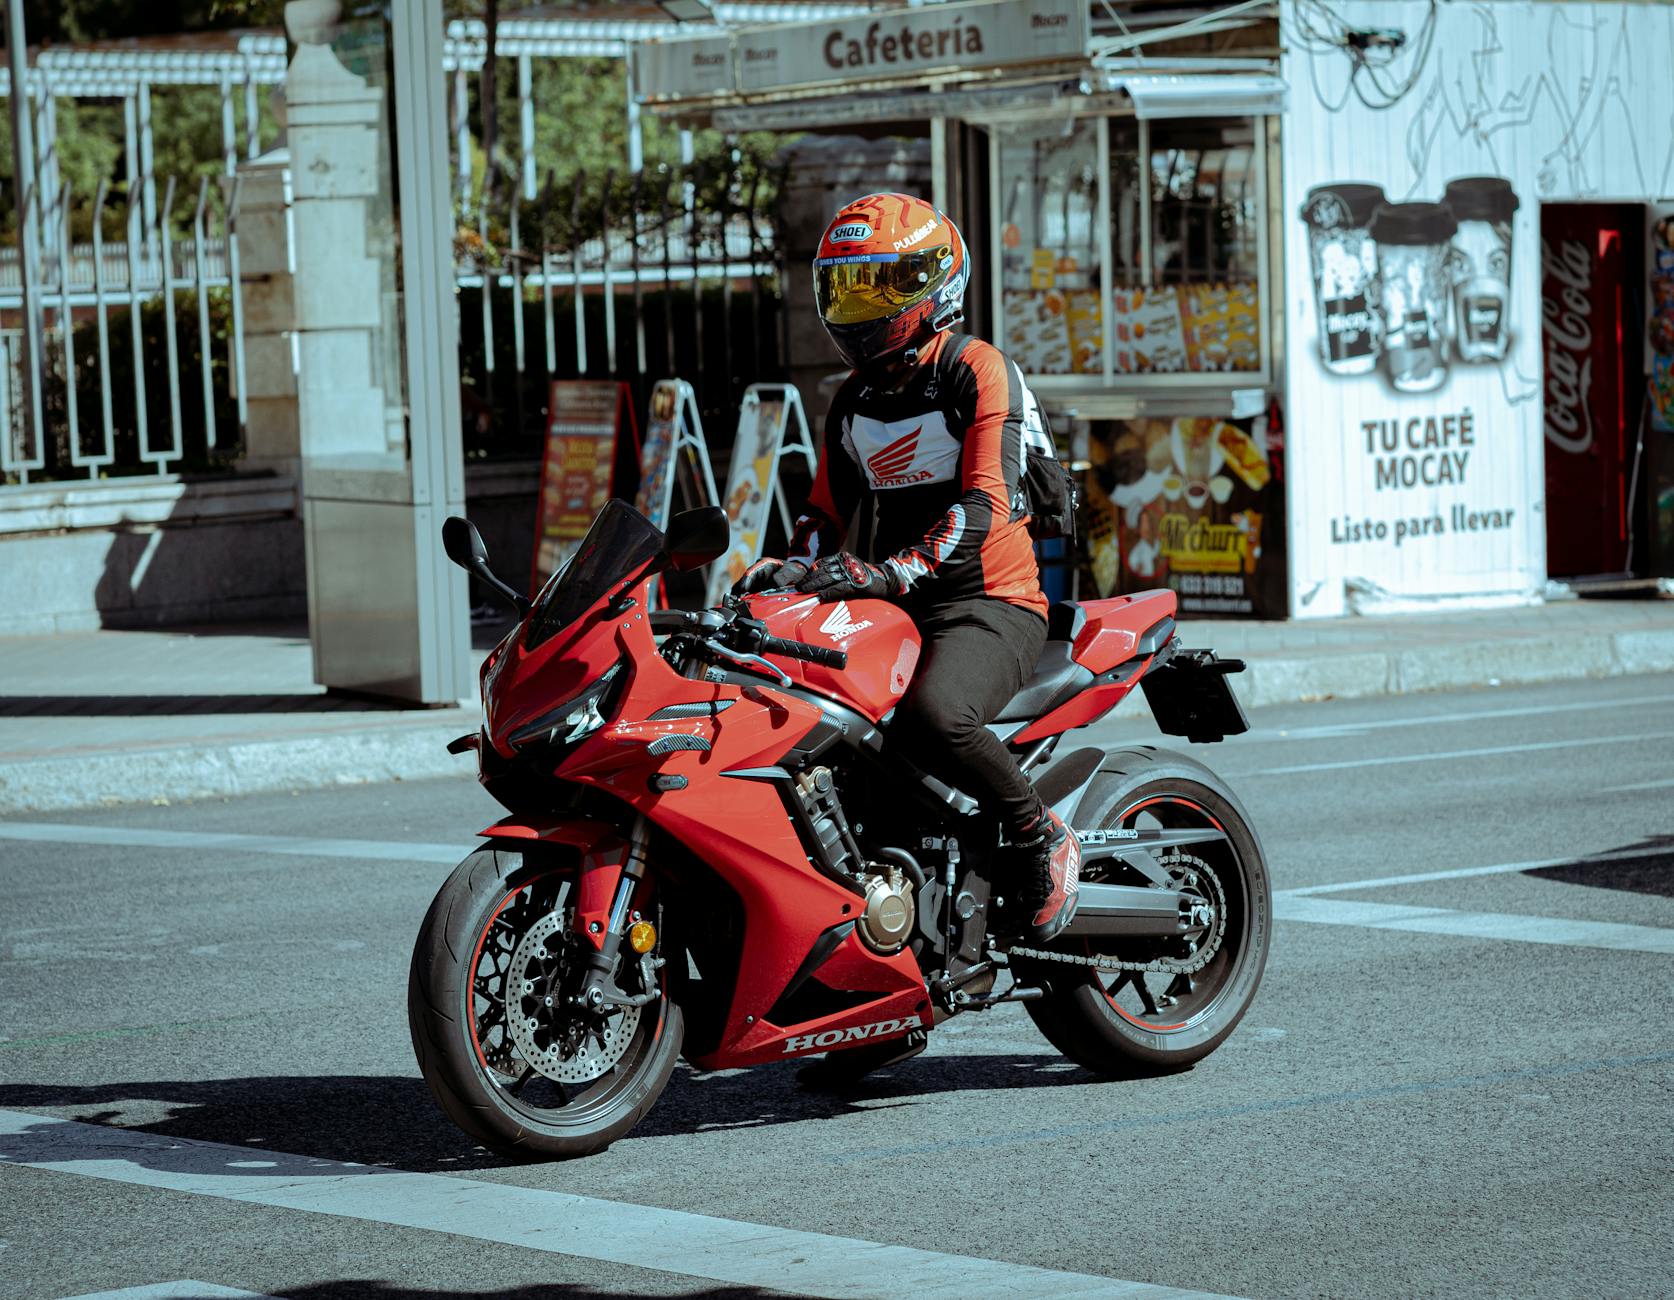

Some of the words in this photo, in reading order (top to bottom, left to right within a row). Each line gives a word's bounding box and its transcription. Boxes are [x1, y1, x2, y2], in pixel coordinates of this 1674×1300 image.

[823, 16, 984, 70] Cafetería
[834, 227, 867, 239] SHOEI
[834, 257, 846, 265] YOU
[848, 255, 871, 264] WINGS
[1361, 420, 1398, 453] TU
[1405, 407, 1475, 450] CAFÉ
[872, 469, 935, 488] HONDA
[1375, 452, 1470, 490] MOCAY
[1331, 517, 1387, 543] Listo
[1395, 514, 1444, 547] para
[1451, 504, 1514, 530] llevar
[830, 619, 874, 642] HONDA
[782, 1014, 922, 1053] HONDA
